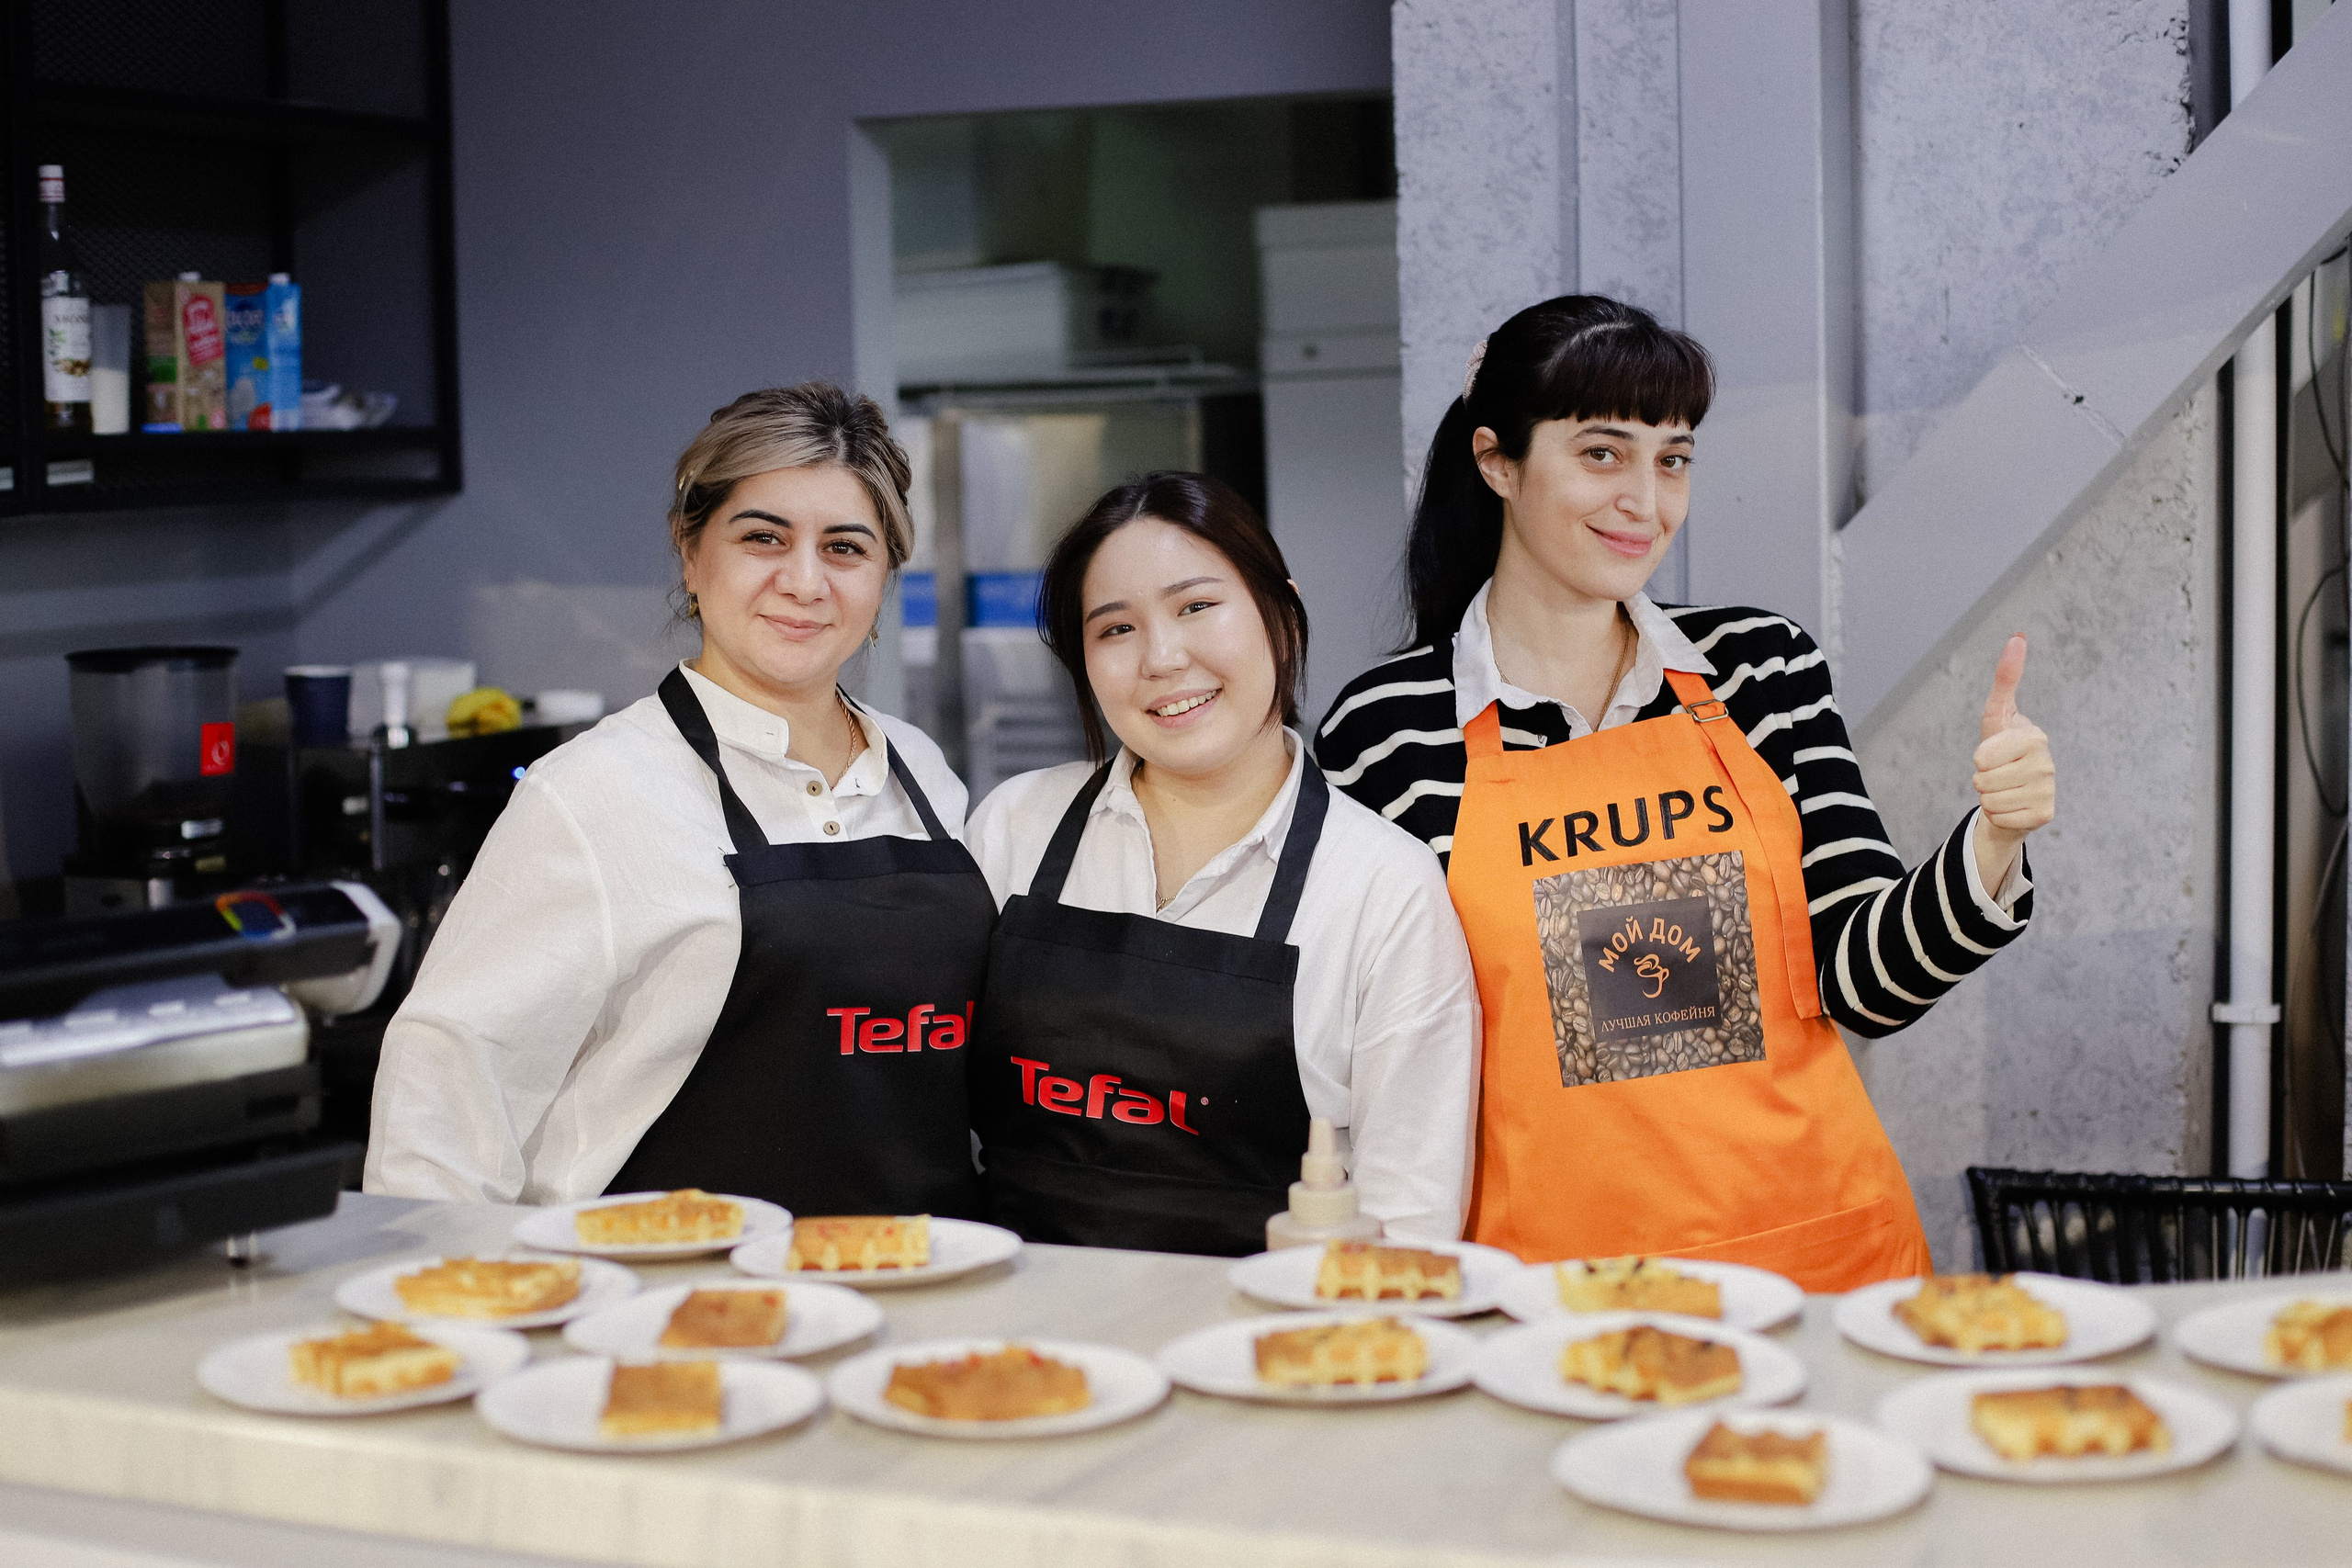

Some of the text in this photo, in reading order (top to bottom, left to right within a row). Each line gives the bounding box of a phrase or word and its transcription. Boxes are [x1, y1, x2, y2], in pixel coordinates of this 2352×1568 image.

[1518, 785, 1735, 866] KRUPS
[1598, 915, 1702, 973] МОЙ ДОМ
[1600, 1006, 1716, 1032] ЛУЧШАЯ КОФЕЙНЯ
